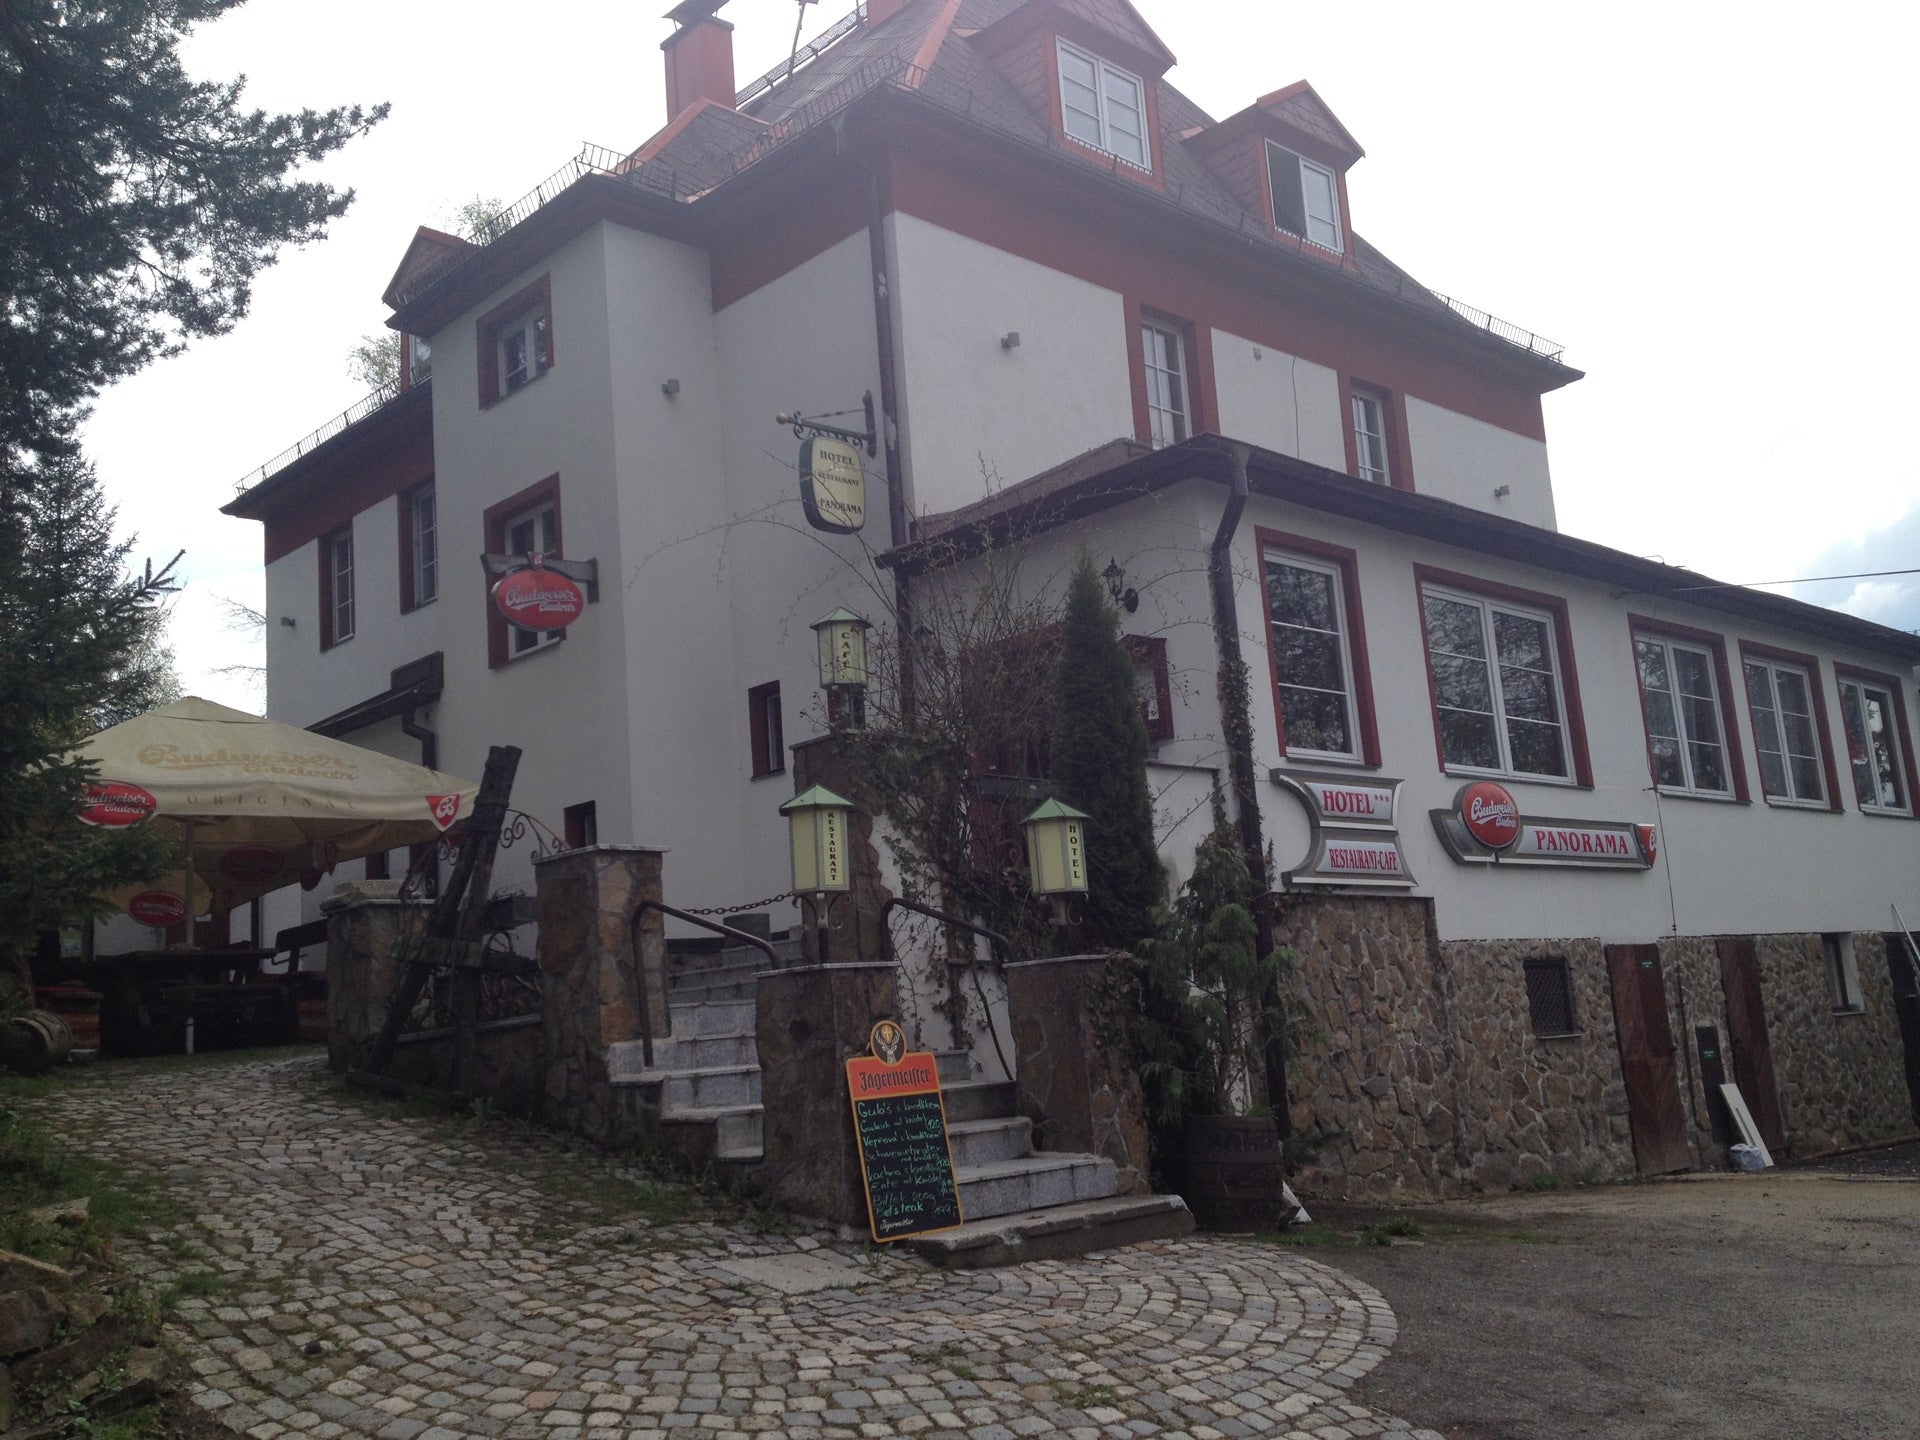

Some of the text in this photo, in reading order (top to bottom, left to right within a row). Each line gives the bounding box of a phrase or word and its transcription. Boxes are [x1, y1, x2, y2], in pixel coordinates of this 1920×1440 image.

[819, 450, 855, 466] HOTEL
[818, 471, 859, 487] RESTAURANT
[820, 498, 862, 515] PANORAMA
[137, 744, 346, 770] Budweiser
[187, 793, 358, 810] ORIGINAL
[1322, 790, 1374, 814] HOTEL
[828, 812, 837, 881] RESTAURANT
[1069, 824, 1081, 879] HOTEL
[1535, 830, 1629, 855] PANORAMA
